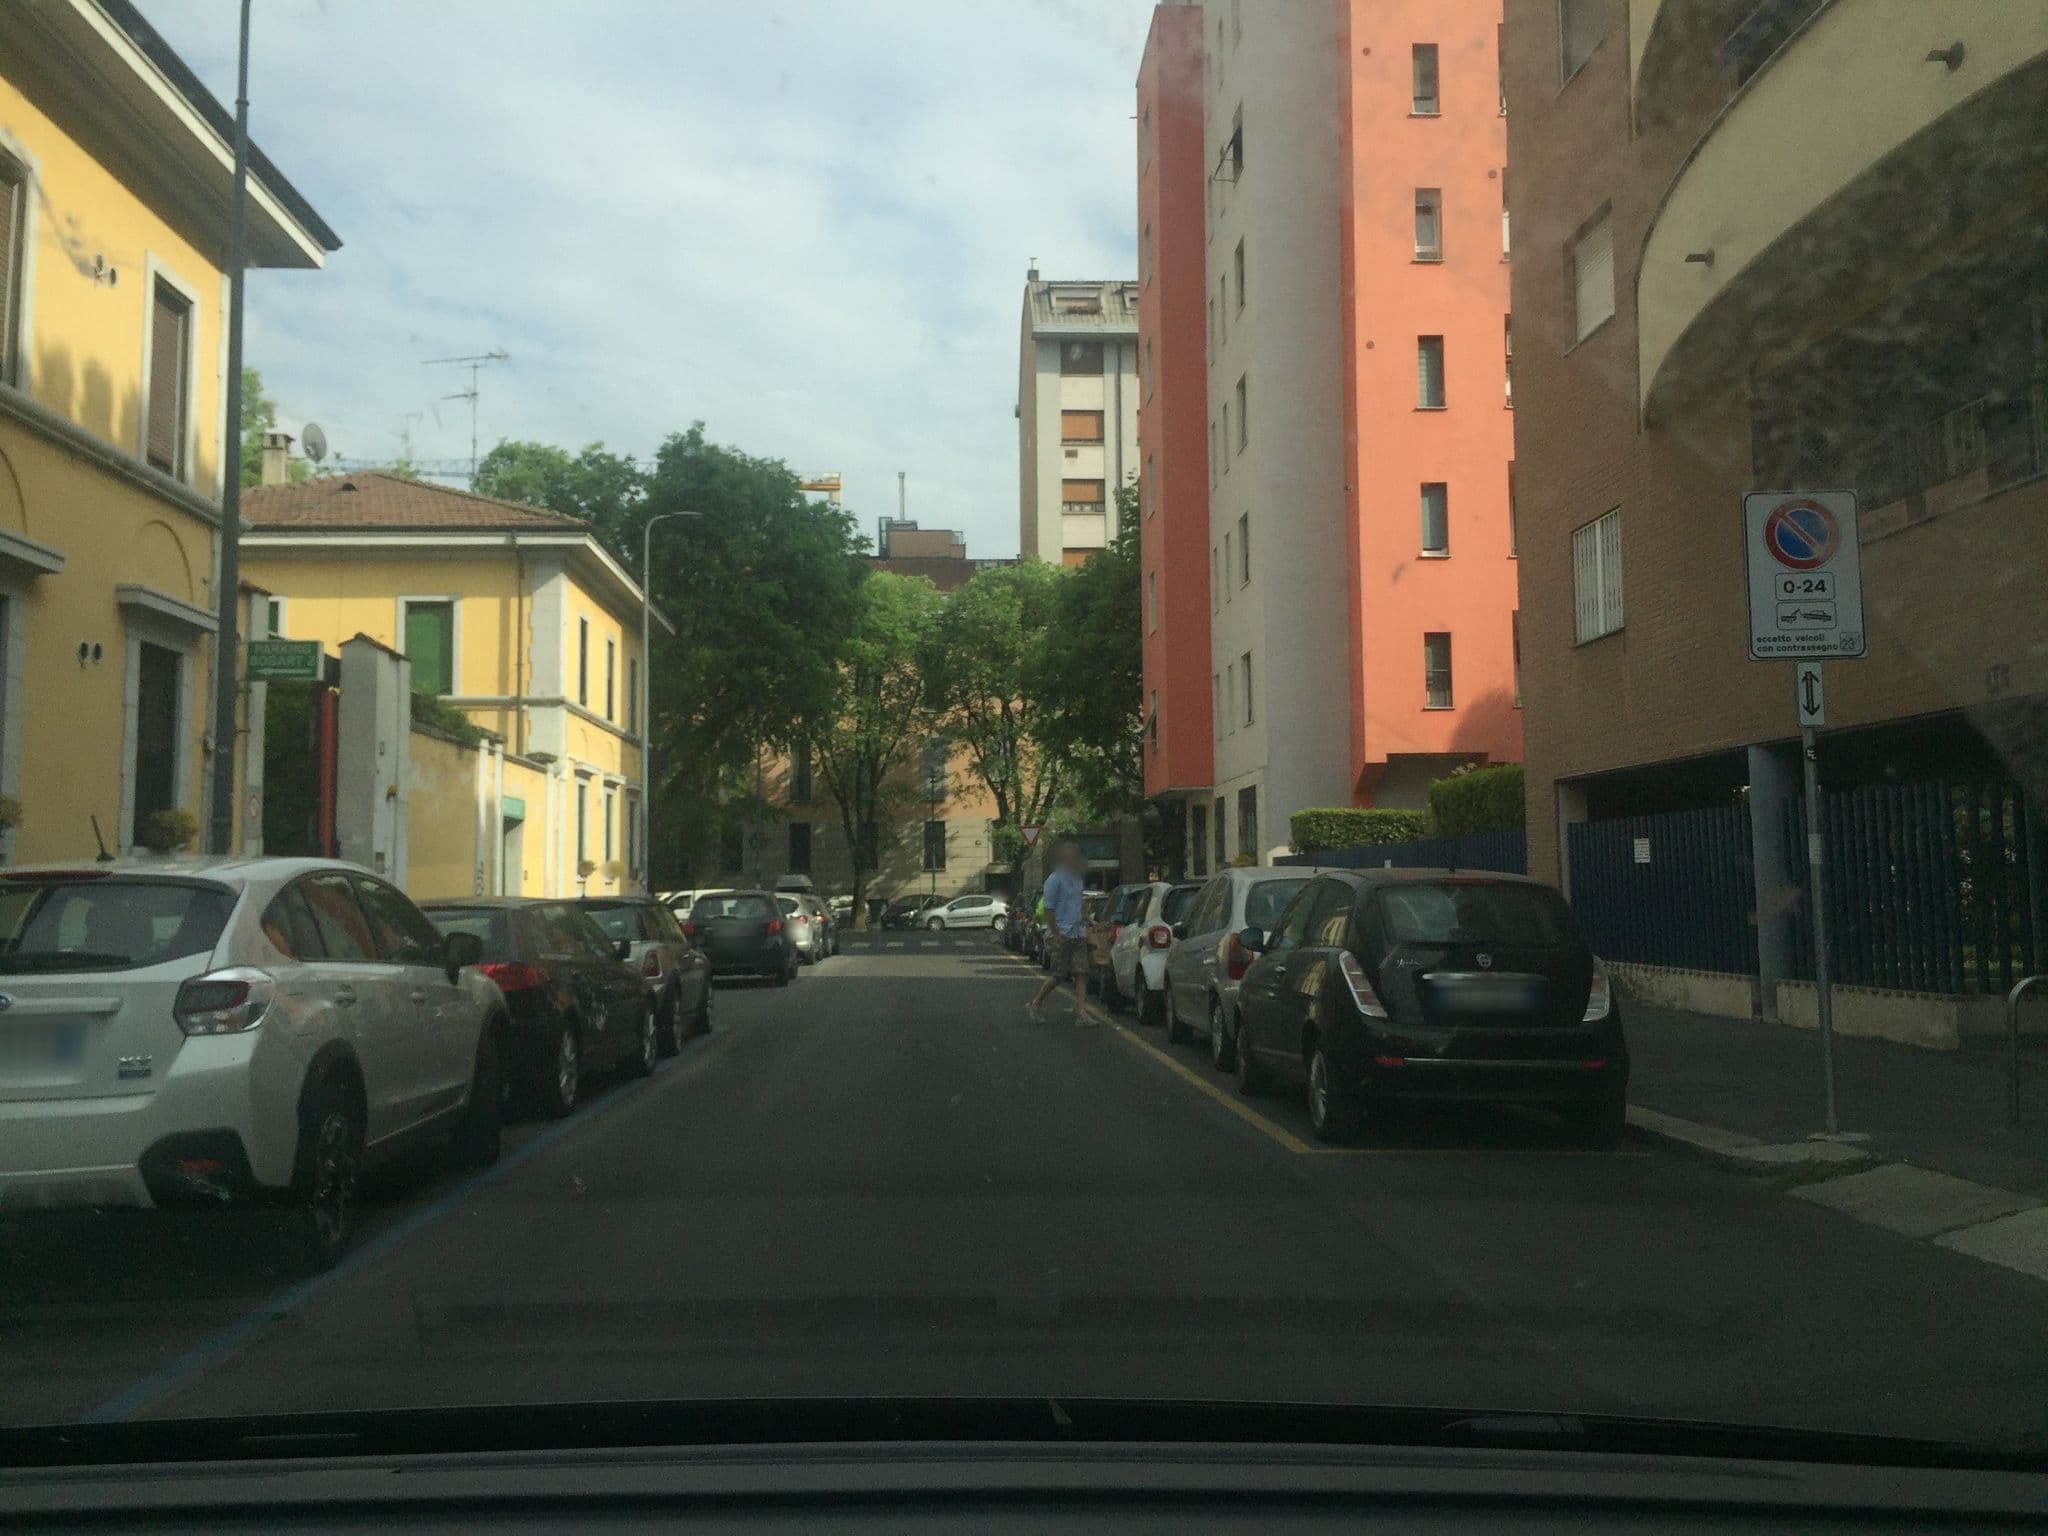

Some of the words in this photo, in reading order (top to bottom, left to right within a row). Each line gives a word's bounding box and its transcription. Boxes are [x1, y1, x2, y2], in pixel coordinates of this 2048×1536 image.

[1783, 579, 1827, 594] 0-24
[1756, 633, 1792, 643] eccetto
[1795, 633, 1825, 642] veicoli
[1756, 645, 1774, 653] con
[1776, 643, 1838, 653] contrassegno
